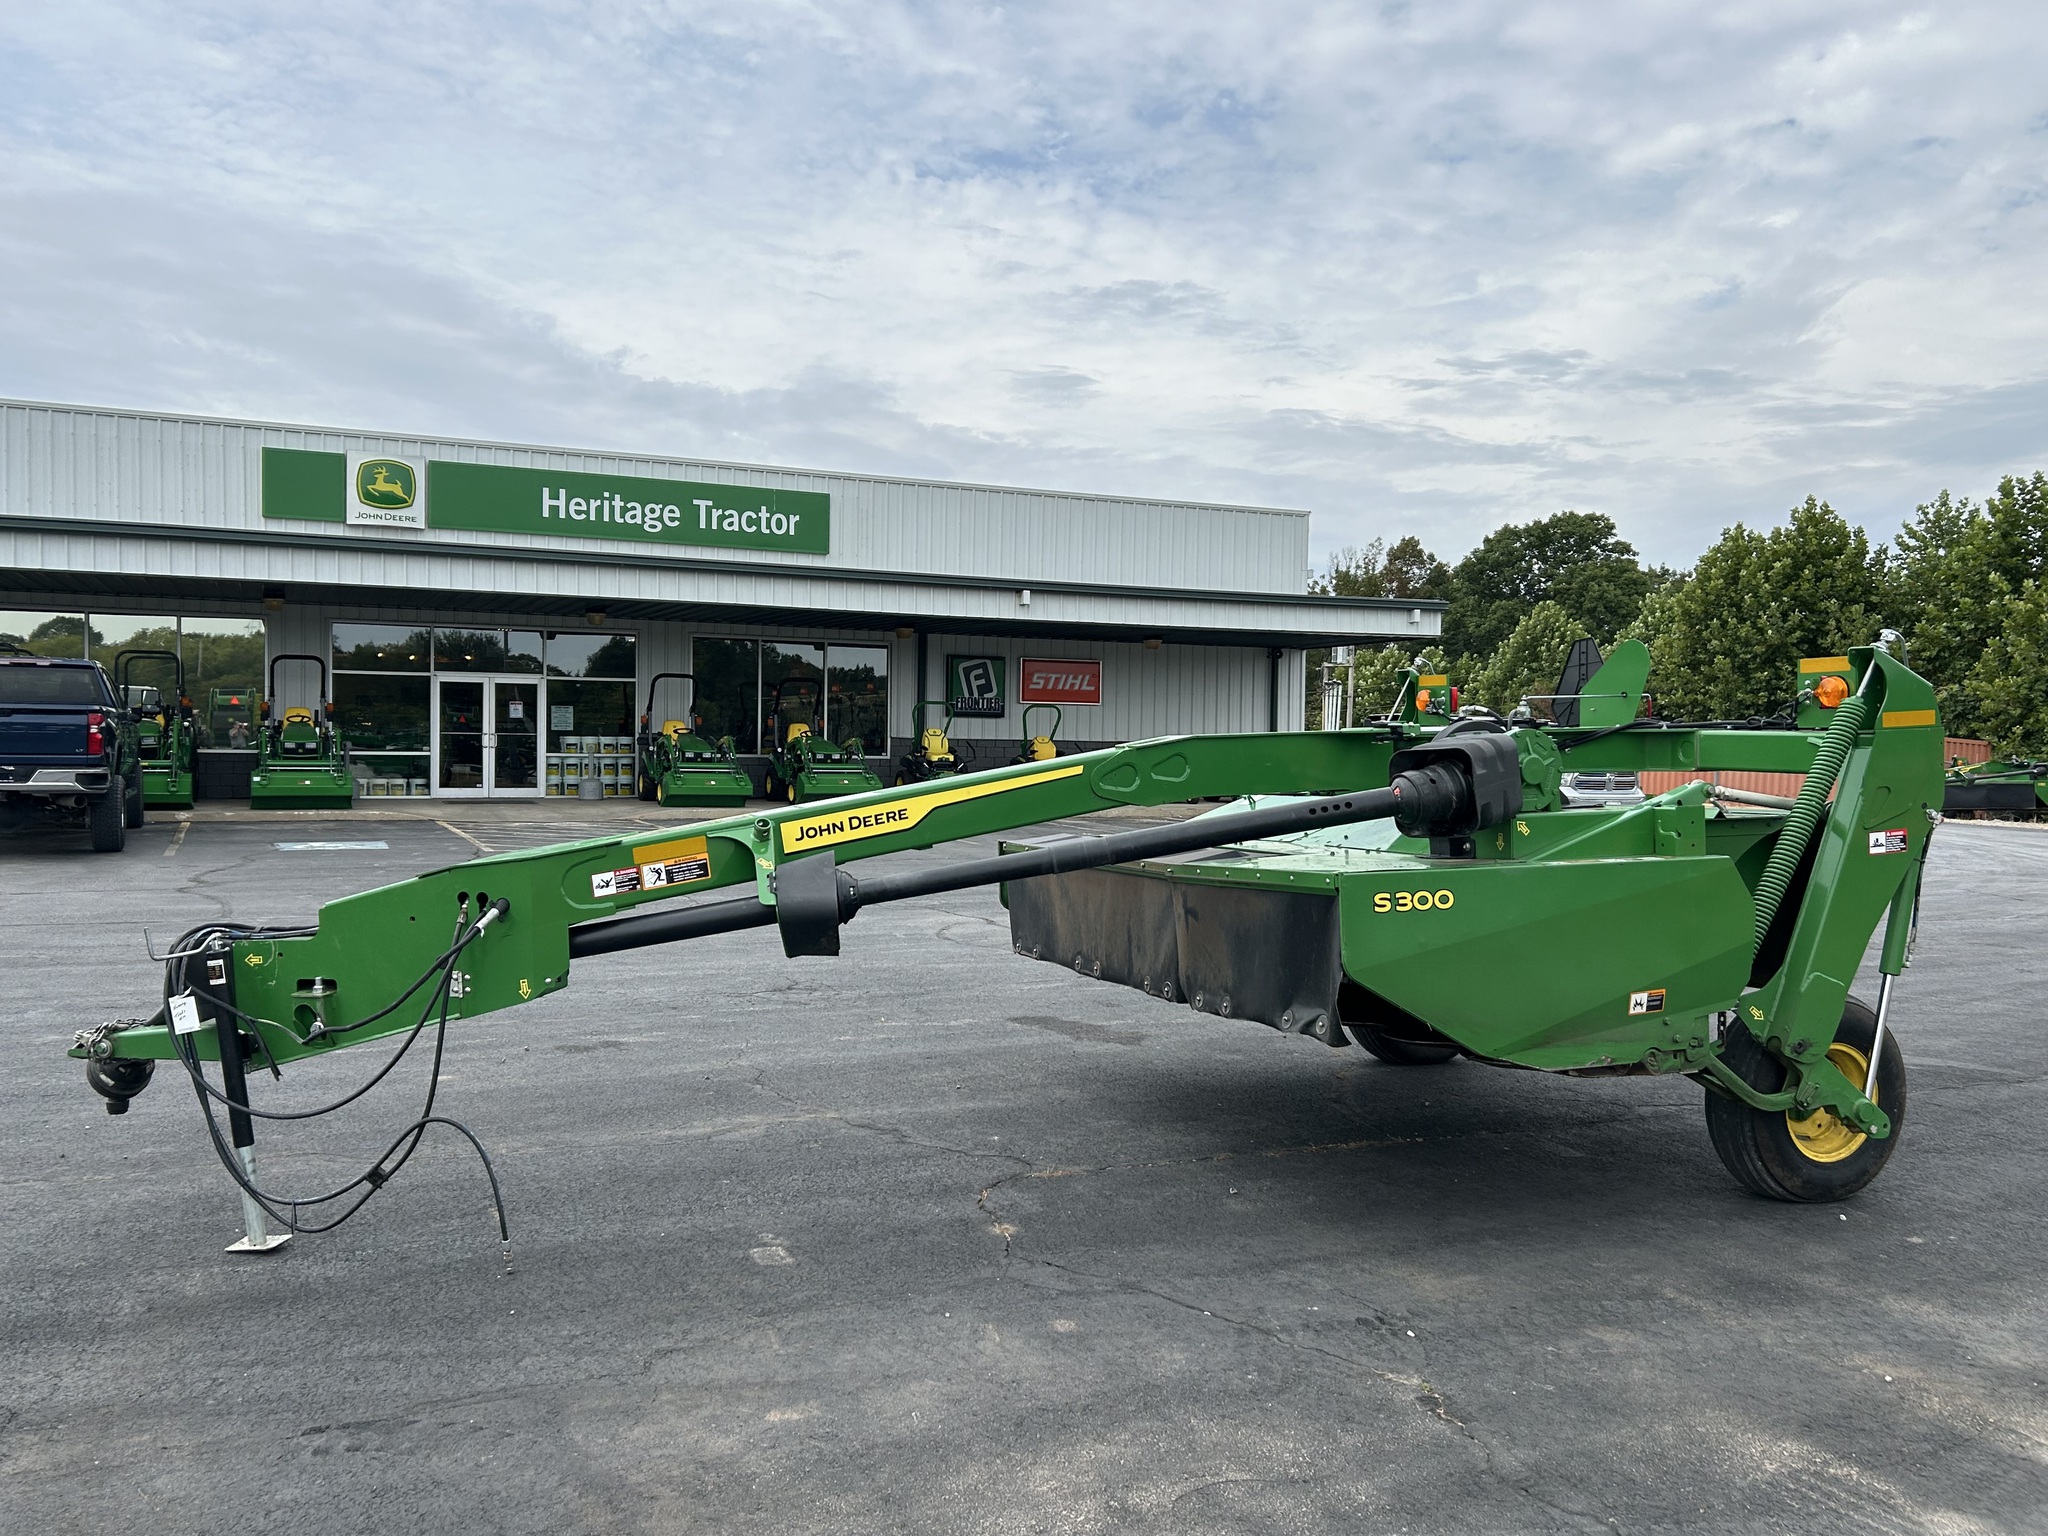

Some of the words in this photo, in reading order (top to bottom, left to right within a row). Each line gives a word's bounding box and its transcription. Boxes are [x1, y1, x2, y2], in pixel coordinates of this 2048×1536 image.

[355, 511, 383, 520] JOHN
[384, 513, 418, 523] DEERE
[542, 487, 681, 533] Heritage
[692, 498, 800, 536] Tractor
[1029, 672, 1096, 691] STIHL
[955, 696, 1001, 712] FRONTIER
[795, 821, 845, 842] JOHN
[848, 808, 909, 831] DEERE
